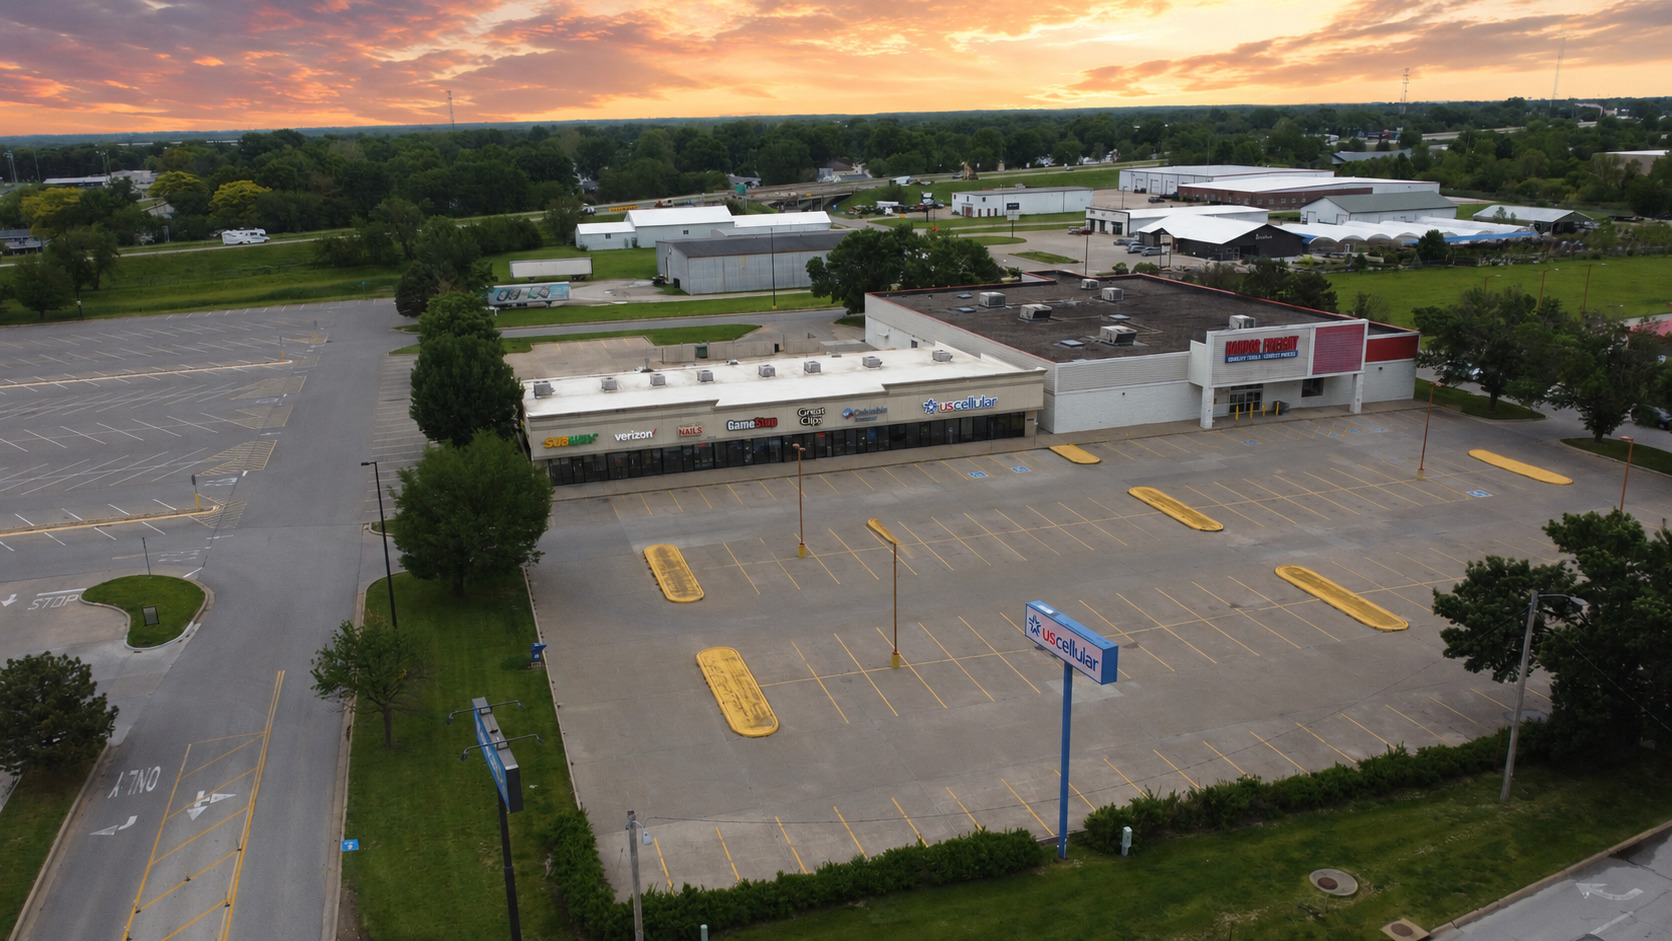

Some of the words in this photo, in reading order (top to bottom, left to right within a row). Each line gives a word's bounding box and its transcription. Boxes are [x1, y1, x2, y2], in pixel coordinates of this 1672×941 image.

[939, 396, 997, 412] uscellular
[797, 407, 825, 417] Great
[727, 417, 777, 430] GameStop
[800, 416, 823, 426] Clips
[615, 431, 653, 441] verizon
[678, 426, 702, 435] NAILS
[28, 594, 80, 610] STOP
[1043, 627, 1099, 671] uscellular
[107, 766, 161, 798] ONLY
